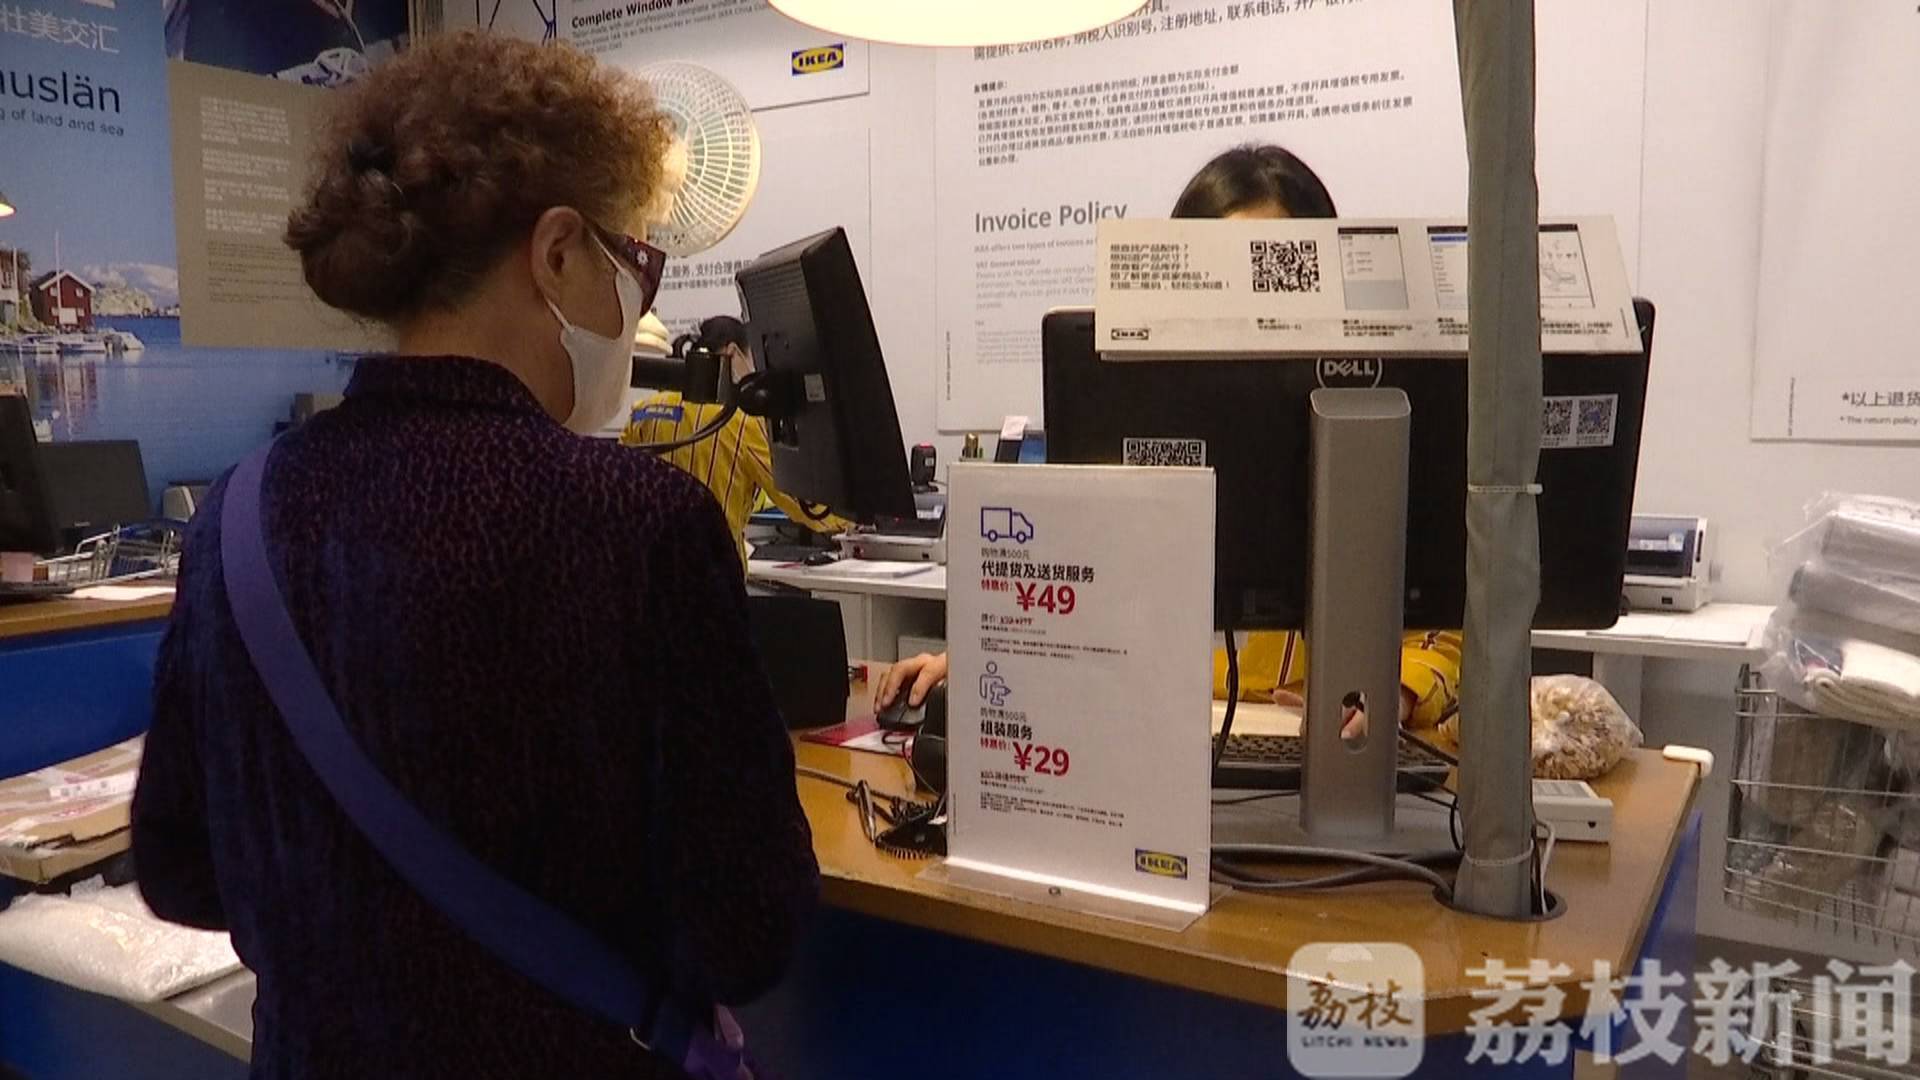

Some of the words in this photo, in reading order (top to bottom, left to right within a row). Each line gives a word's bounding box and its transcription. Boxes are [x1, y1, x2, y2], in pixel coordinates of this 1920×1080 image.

[571, 8, 623, 29] Complete
[626, 0, 673, 17] Window
[12, 109, 25, 121] of
[32, 110, 63, 127] land
[68, 119, 95, 132] and
[101, 123, 124, 137] sea
[975, 207, 1052, 233] Invoice
[1059, 200, 1127, 226] Policy
[1324, 359, 1375, 377] DELL
[981, 562, 1095, 583] 代提货及送货服务
[1015, 581, 1076, 615] ¥49
[980, 719, 1033, 741] 组装服务
[1012, 741, 1070, 777] ¥29
